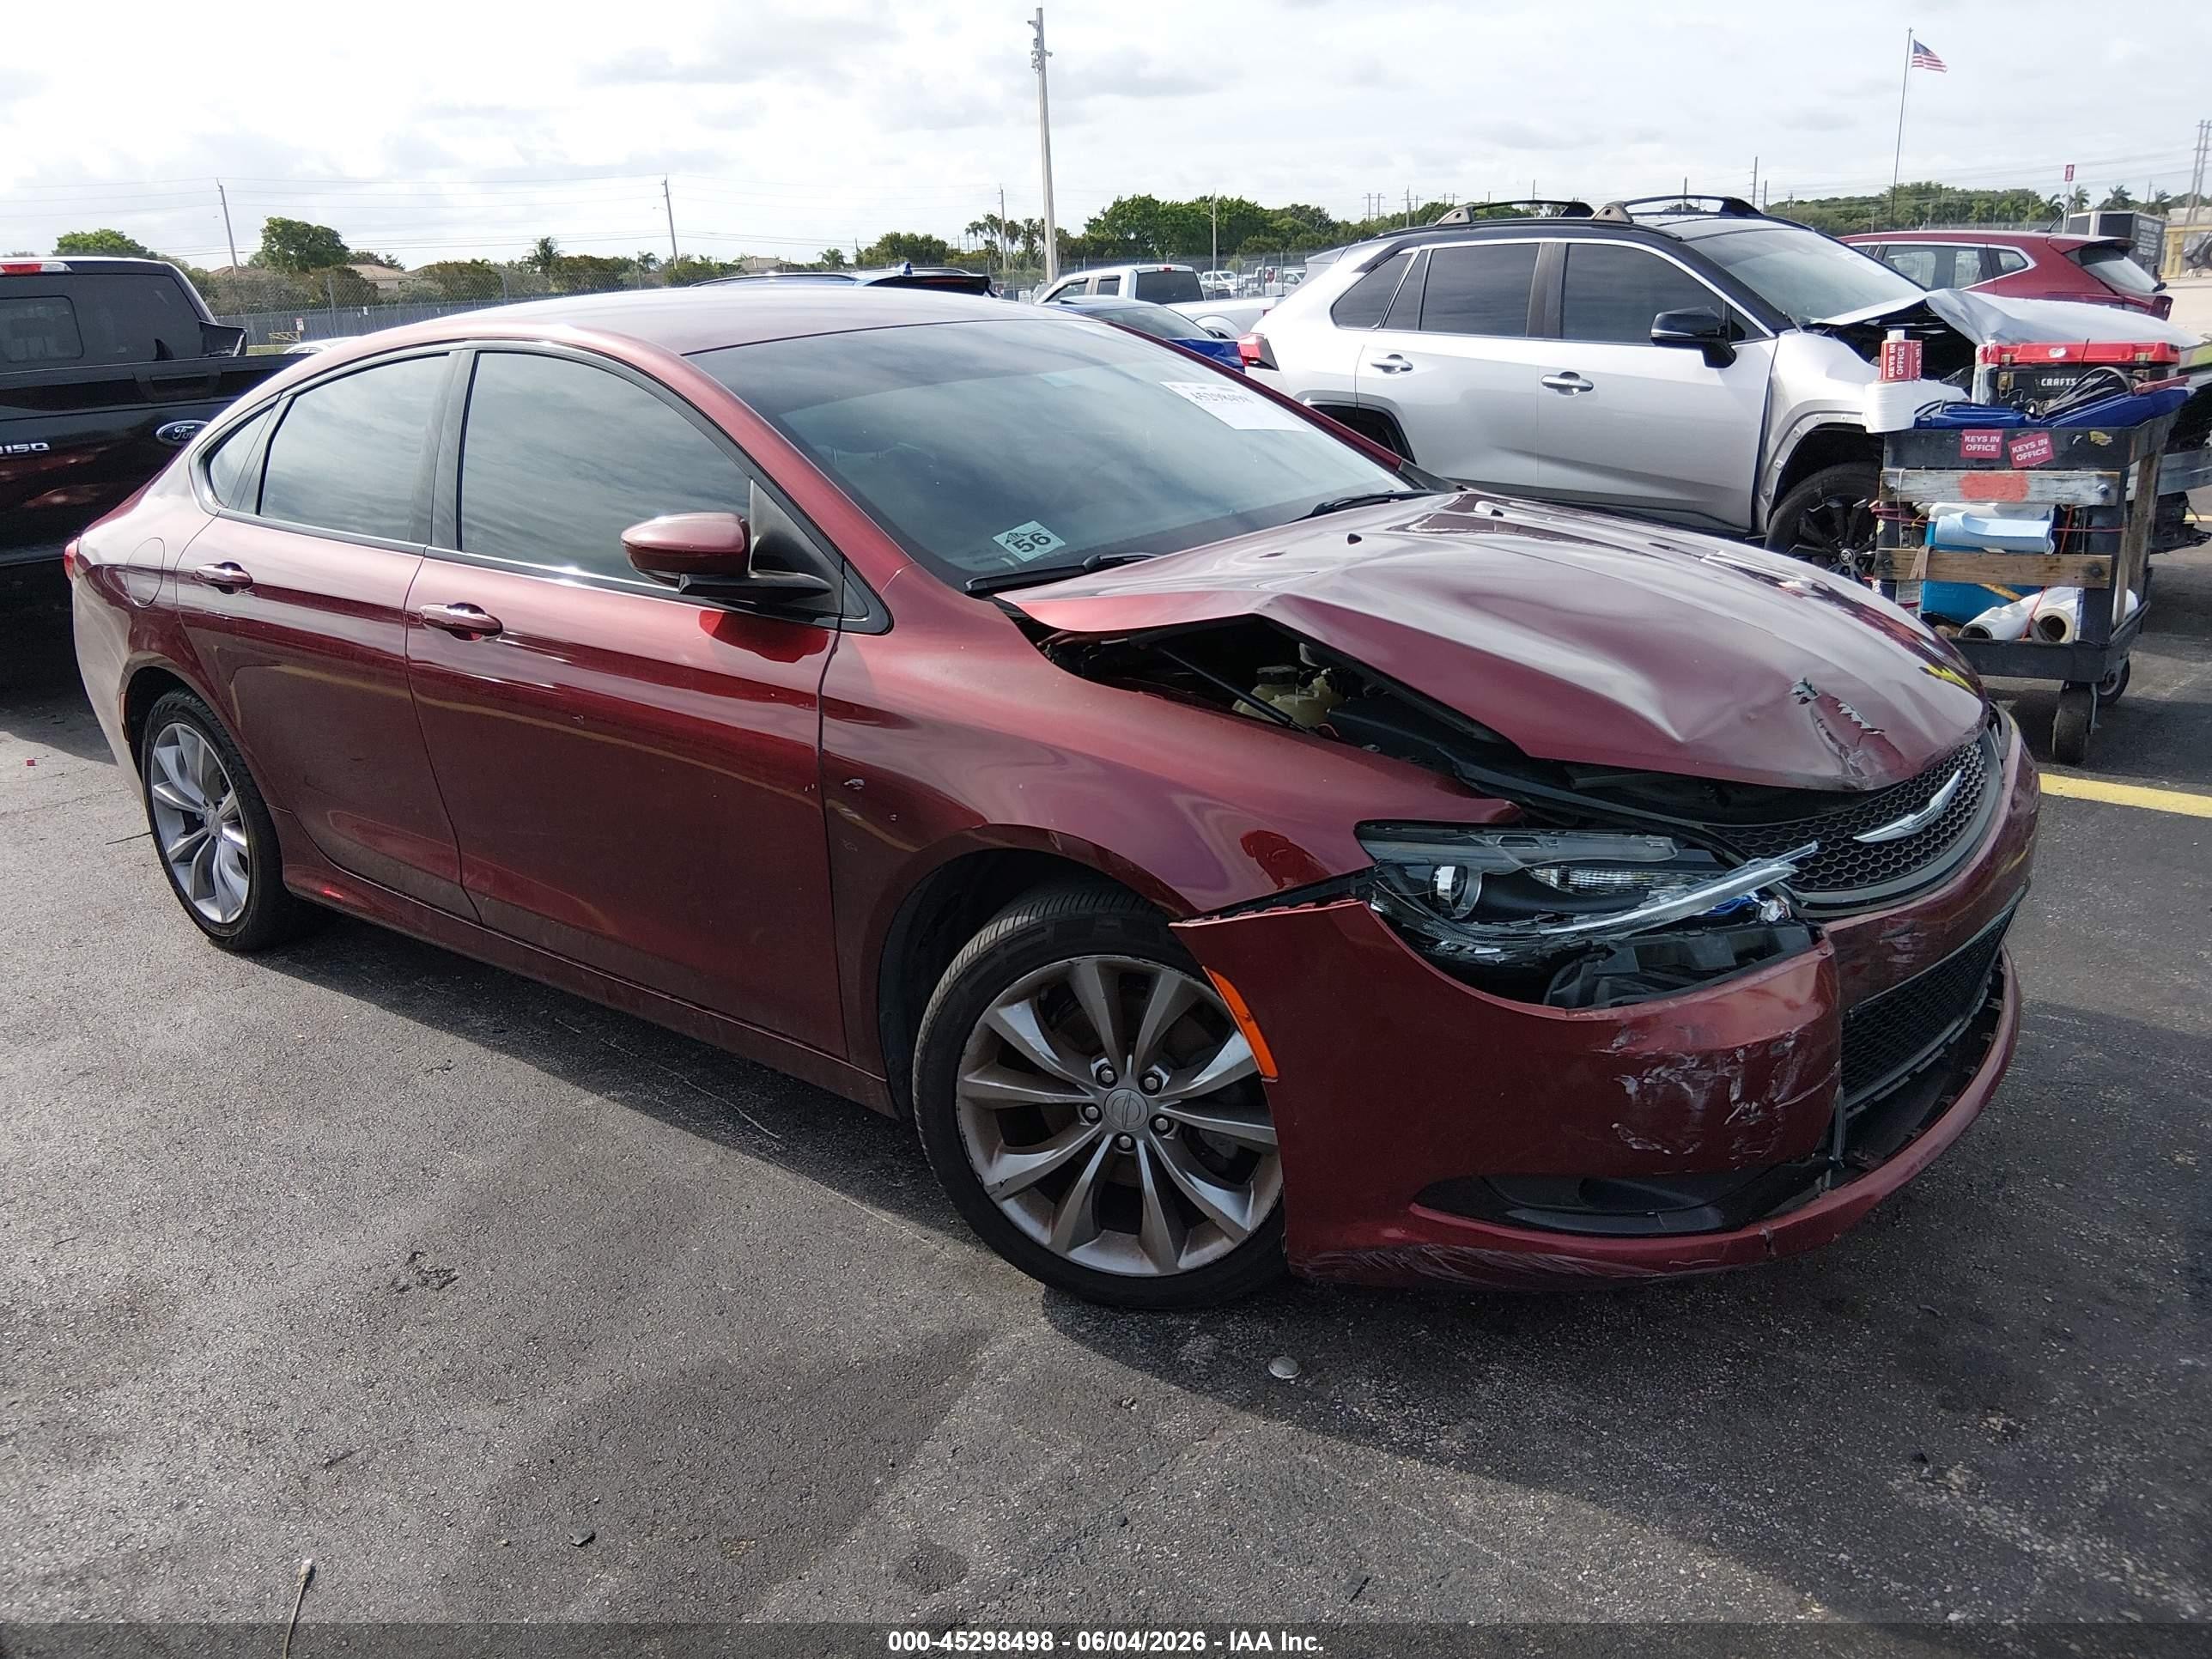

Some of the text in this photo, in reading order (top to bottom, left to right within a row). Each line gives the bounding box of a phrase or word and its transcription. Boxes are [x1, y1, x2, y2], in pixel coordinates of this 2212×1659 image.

[1889, 343, 1896, 353] IN
[1896, 345, 1905, 375] OFFICE
[0, 442, 50, 454] 150
[2012, 441, 2036, 453] KEYS
[2016, 447, 2048, 461] OFFICE
[1012, 532, 1051, 553] 56
